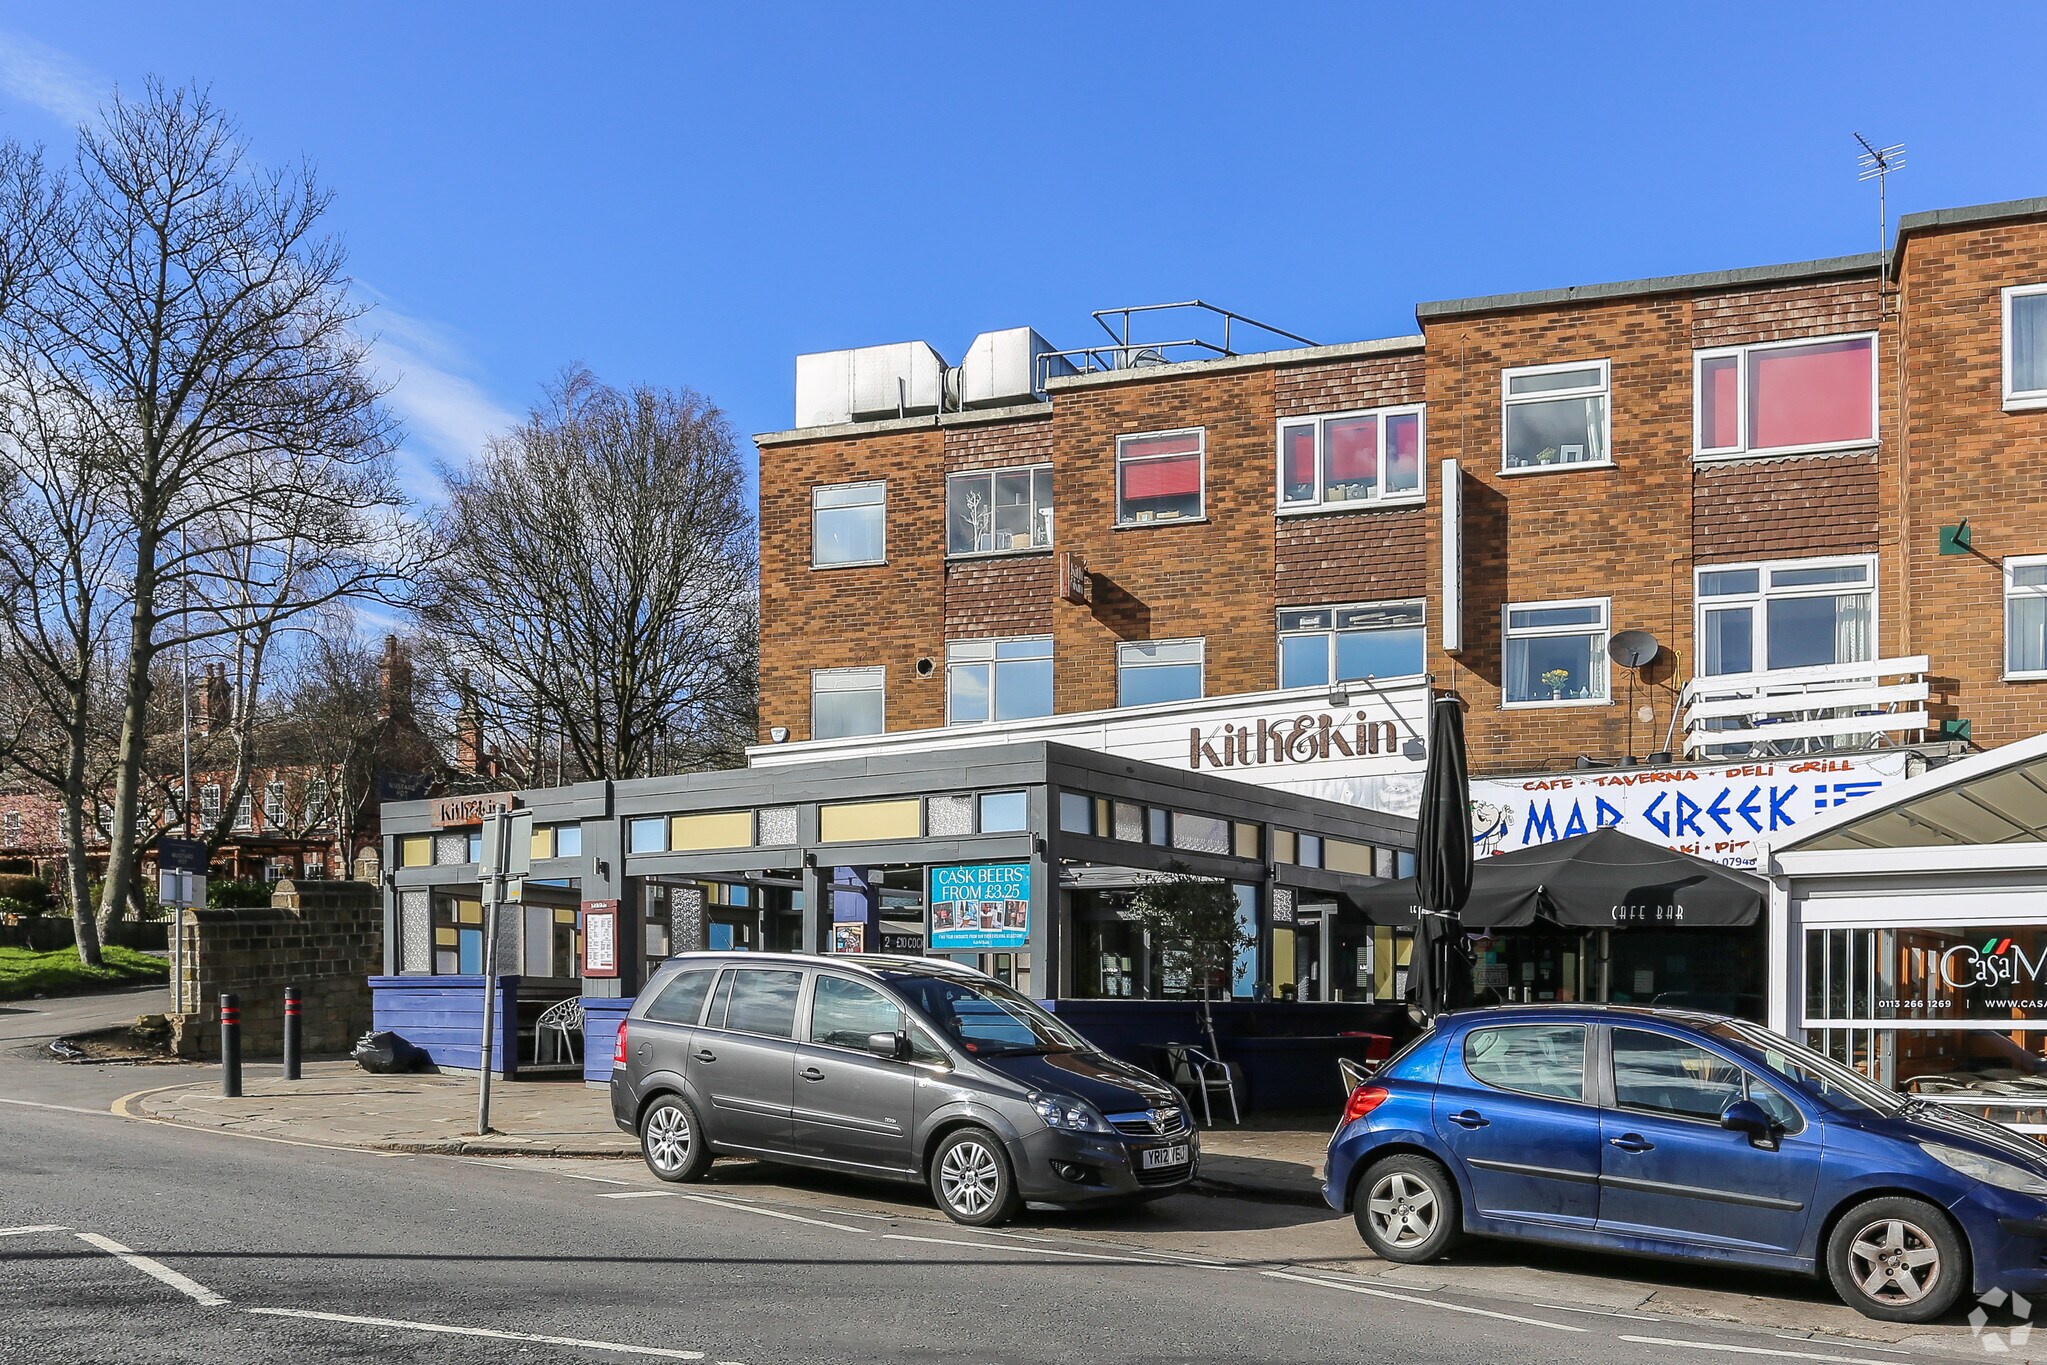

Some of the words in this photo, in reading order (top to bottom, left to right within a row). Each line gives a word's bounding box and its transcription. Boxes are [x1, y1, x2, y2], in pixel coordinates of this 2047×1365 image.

[1522, 778, 1574, 792] CAFE
[1593, 769, 1699, 787] TAVERNA
[1522, 795, 1624, 845] MAD
[1642, 784, 1799, 838] GREEK
[938, 869, 976, 885] CASK
[978, 867, 1023, 883] BEERS
[942, 885, 982, 900] FROM
[984, 883, 1020, 899] £3.25
[1611, 905, 1646, 920] CAFE
[1655, 904, 1684, 920] BAR
[1878, 999, 1901, 1008] 0113
[1904, 999, 1924, 1008] 266
[1927, 999, 1951, 1008] 1269
[1148, 1148, 1169, 1165] YR12
